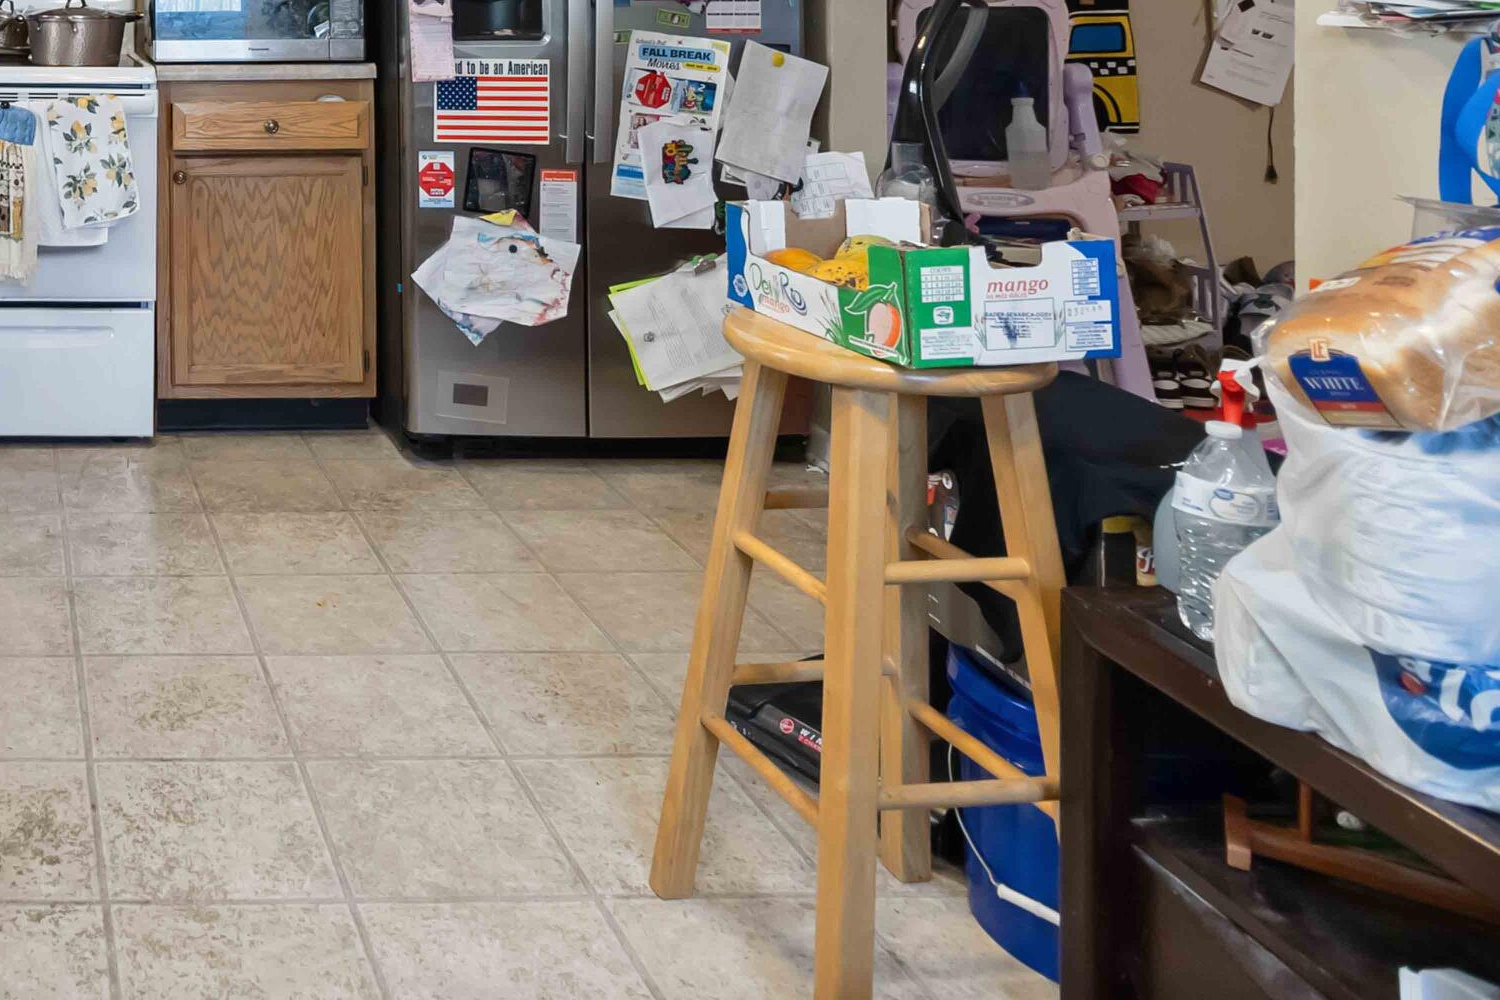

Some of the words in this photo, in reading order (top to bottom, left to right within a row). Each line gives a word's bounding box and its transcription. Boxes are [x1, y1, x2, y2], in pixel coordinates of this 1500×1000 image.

[642, 47, 668, 58] FALL
[670, 50, 712, 61] BREAK
[466, 61, 476, 75] to
[479, 61, 490, 75] be
[493, 62, 504, 75] an
[508, 61, 548, 75] American
[647, 58, 680, 71] Movies
[698, 83, 706, 92] 2
[986, 278, 1049, 295] mango
[1303, 377, 1364, 390] WHITE
